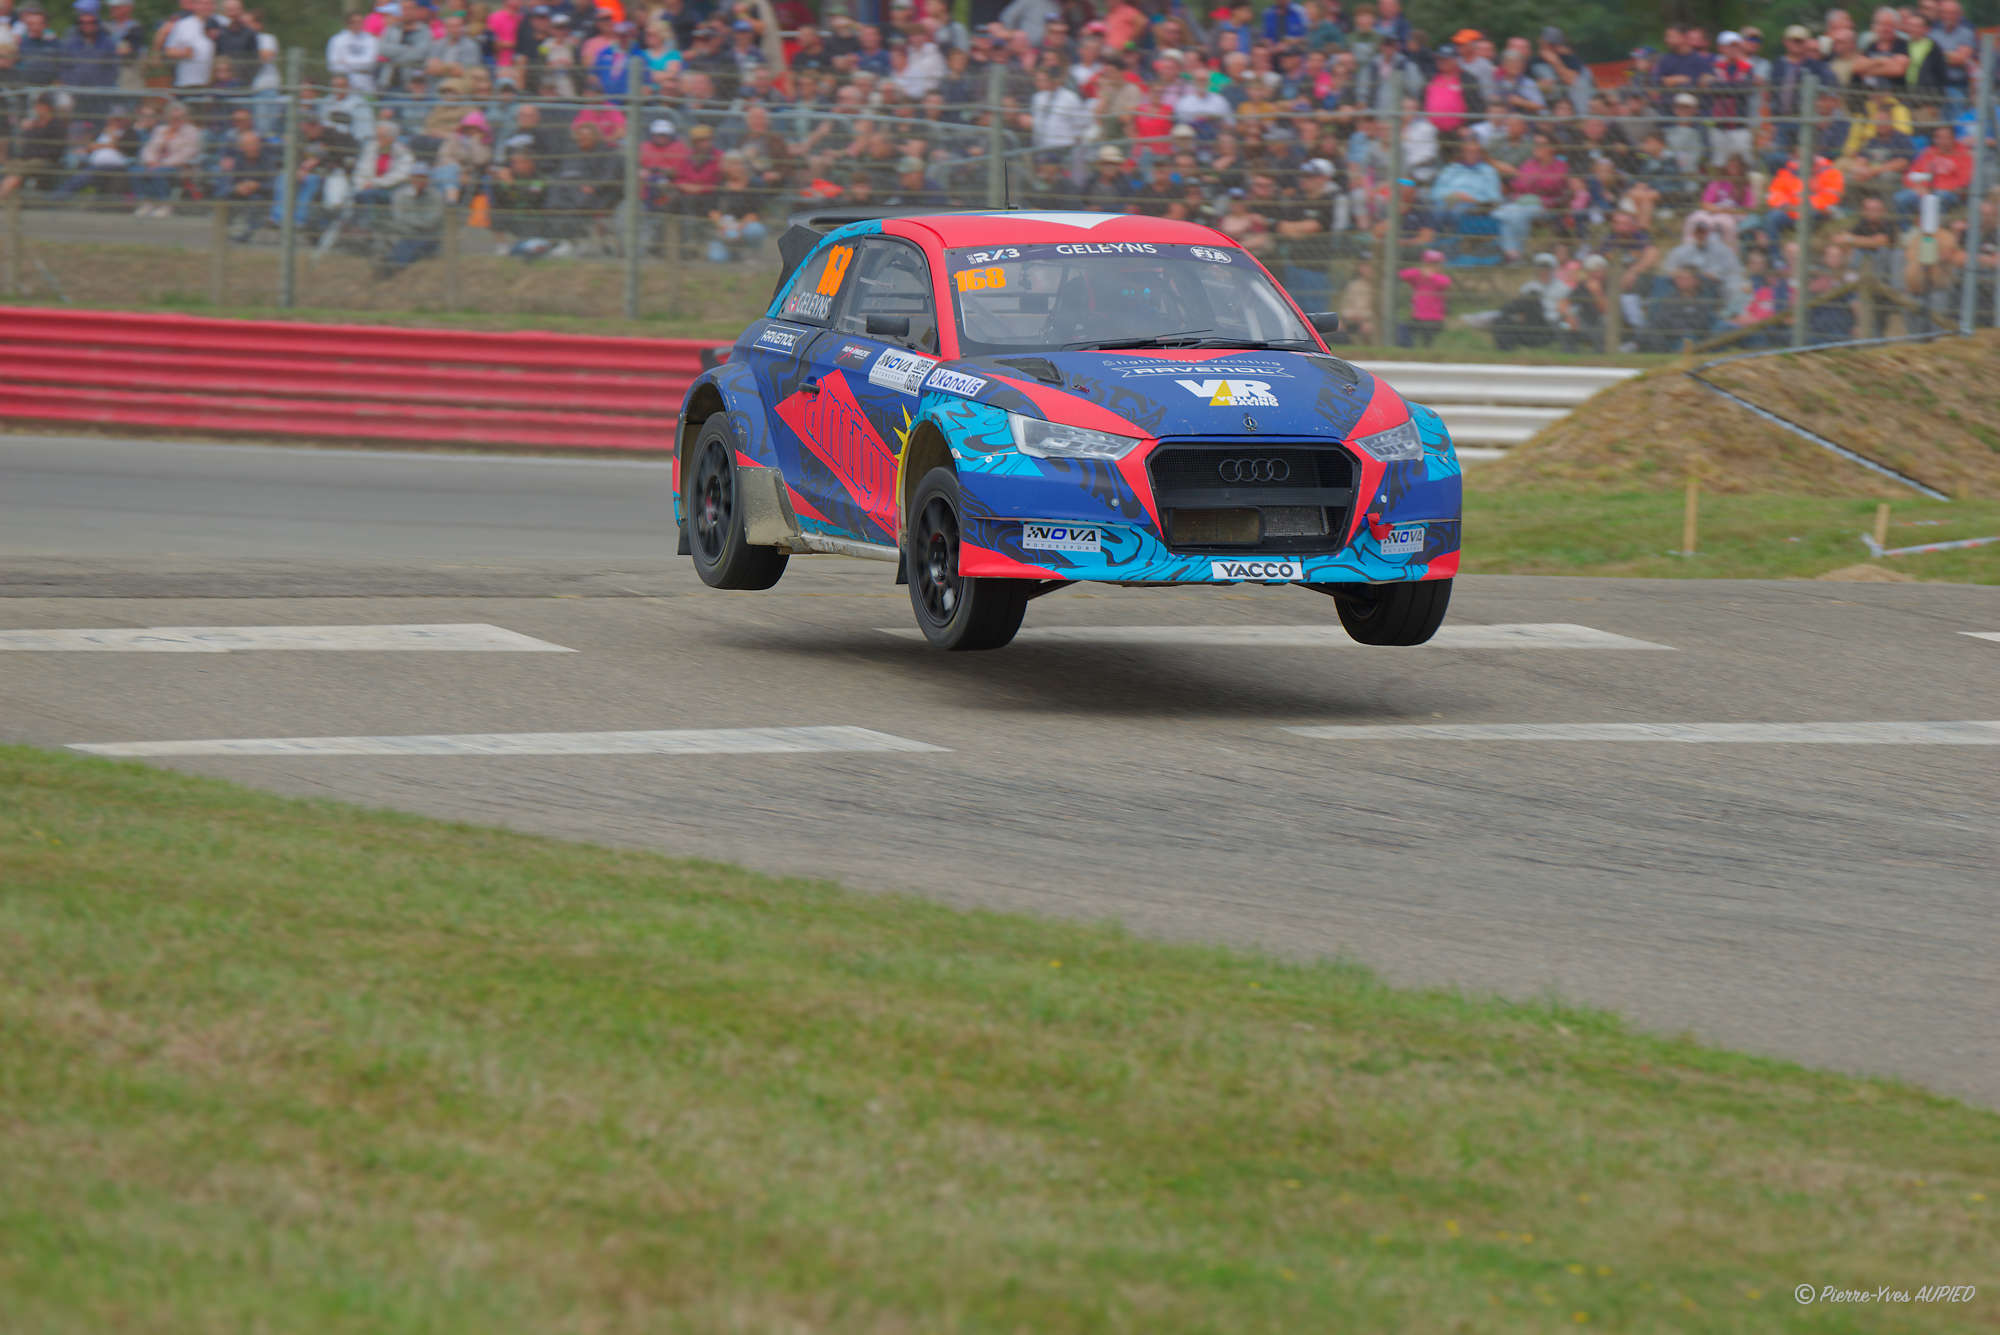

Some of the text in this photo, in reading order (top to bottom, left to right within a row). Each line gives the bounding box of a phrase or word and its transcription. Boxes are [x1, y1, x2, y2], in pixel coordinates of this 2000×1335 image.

[1056, 243, 1158, 255] GELEYNS
[1192, 247, 1230, 262] FIA
[816, 245, 854, 297] 168
[953, 267, 1007, 293] 168
[798, 291, 832, 320] GELEYNS
[1133, 366, 1276, 375] RAVENOL
[1036, 527, 1097, 542] NOVA
[1220, 562, 1294, 578] YACCO
